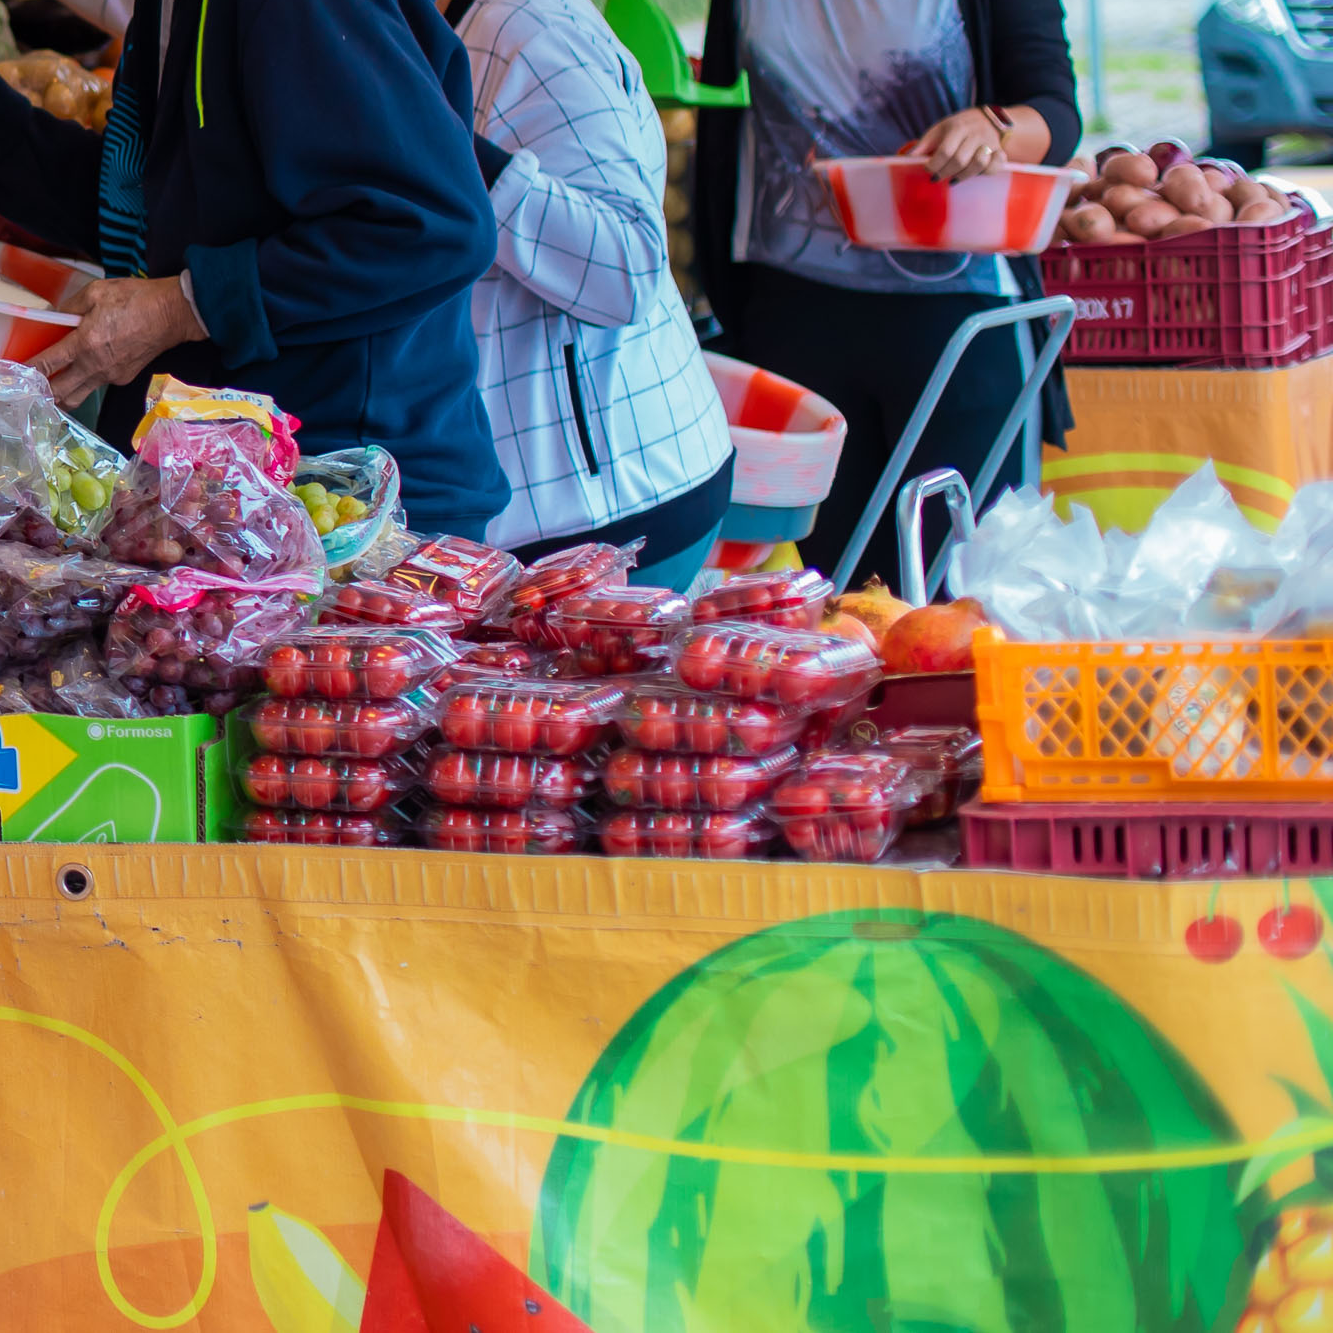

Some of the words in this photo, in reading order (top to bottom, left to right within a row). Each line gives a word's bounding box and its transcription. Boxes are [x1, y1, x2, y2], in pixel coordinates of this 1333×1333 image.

[1074, 297, 1110, 321] BOX
[1112, 297, 1134, 319] 17
[107, 724, 173, 739] Formosa
